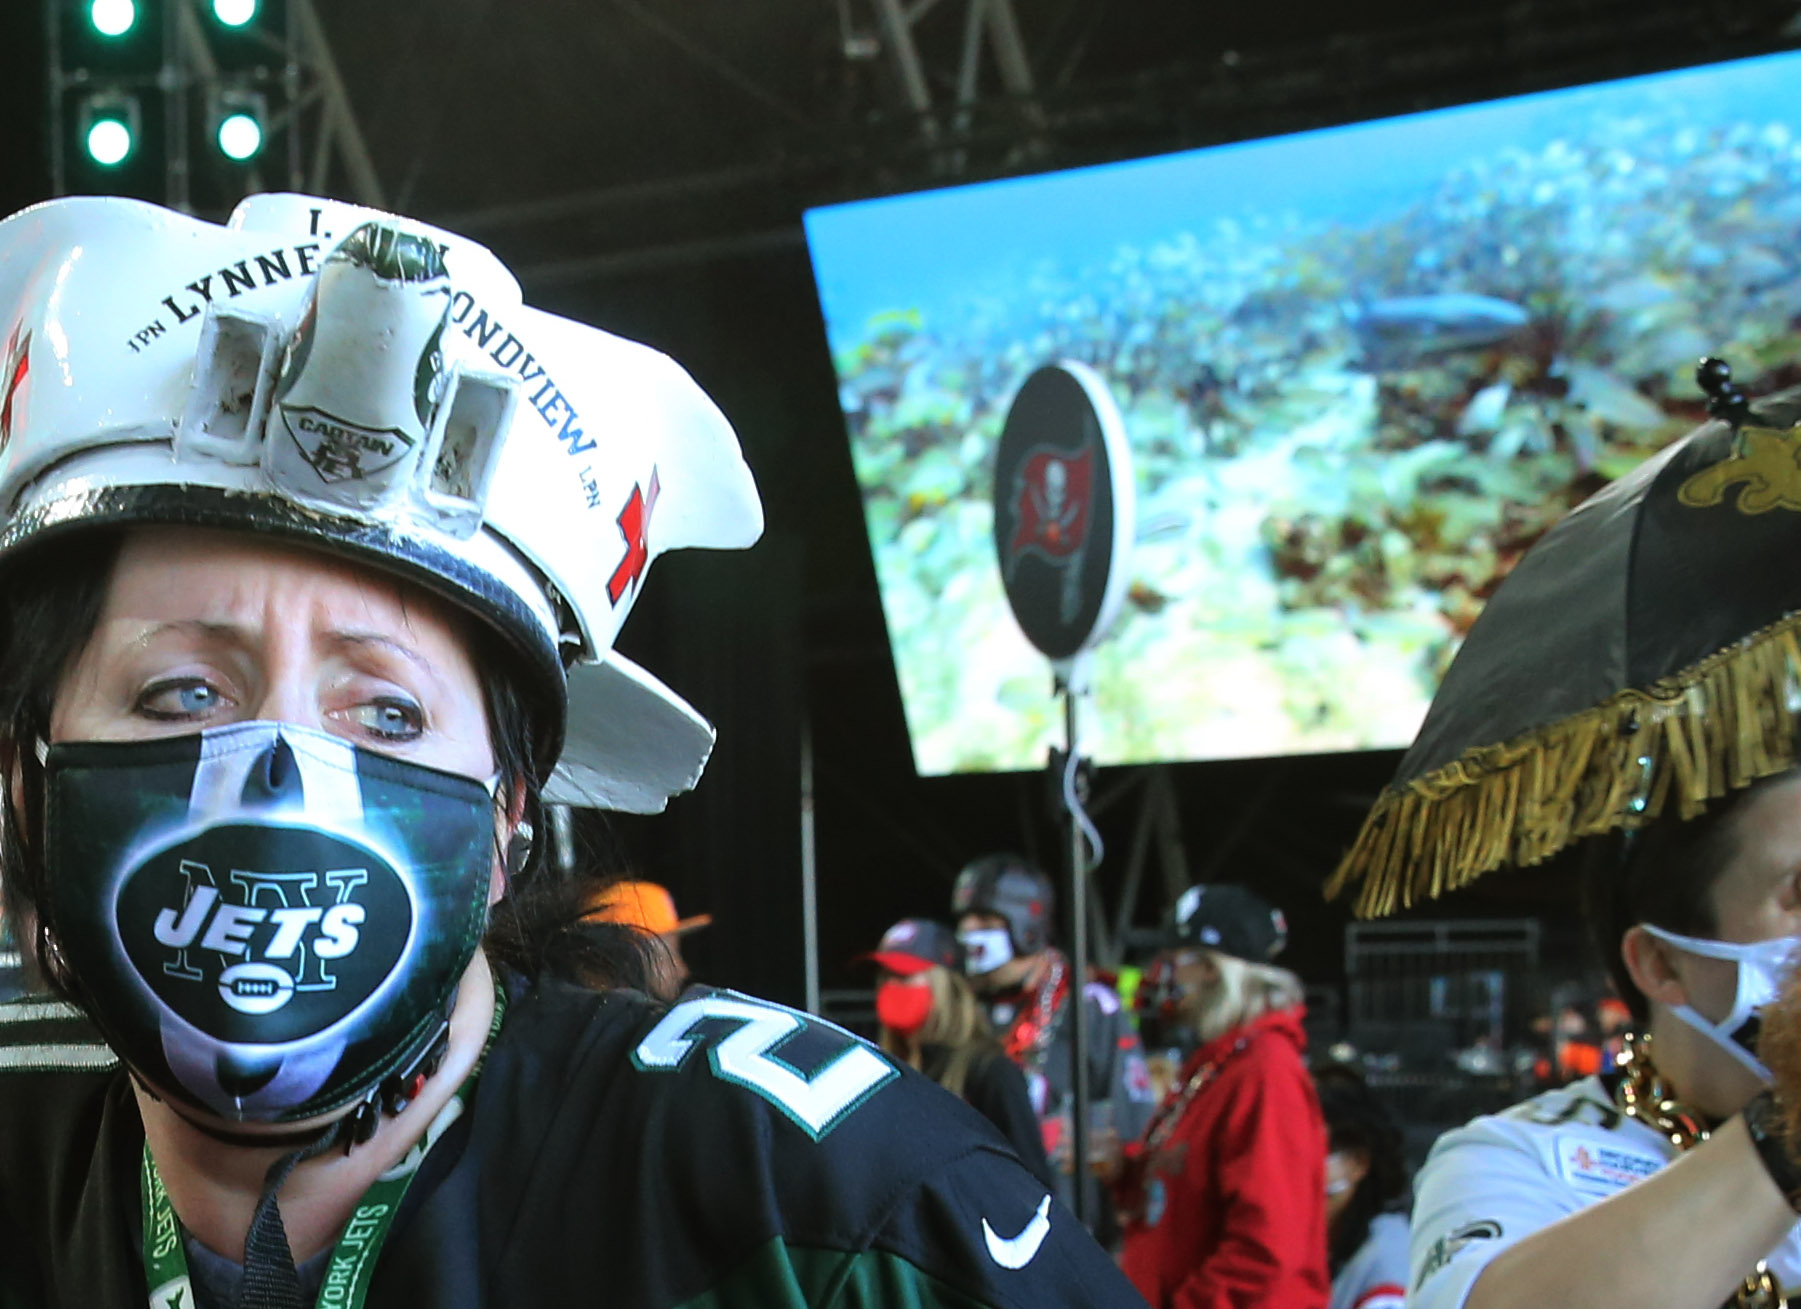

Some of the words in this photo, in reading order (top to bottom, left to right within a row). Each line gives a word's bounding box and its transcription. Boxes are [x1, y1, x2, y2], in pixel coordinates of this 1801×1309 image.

[452, 290, 598, 456] ONDVIEW
[153, 885, 366, 961] JETS
[342, 1202, 390, 1251] JETS
